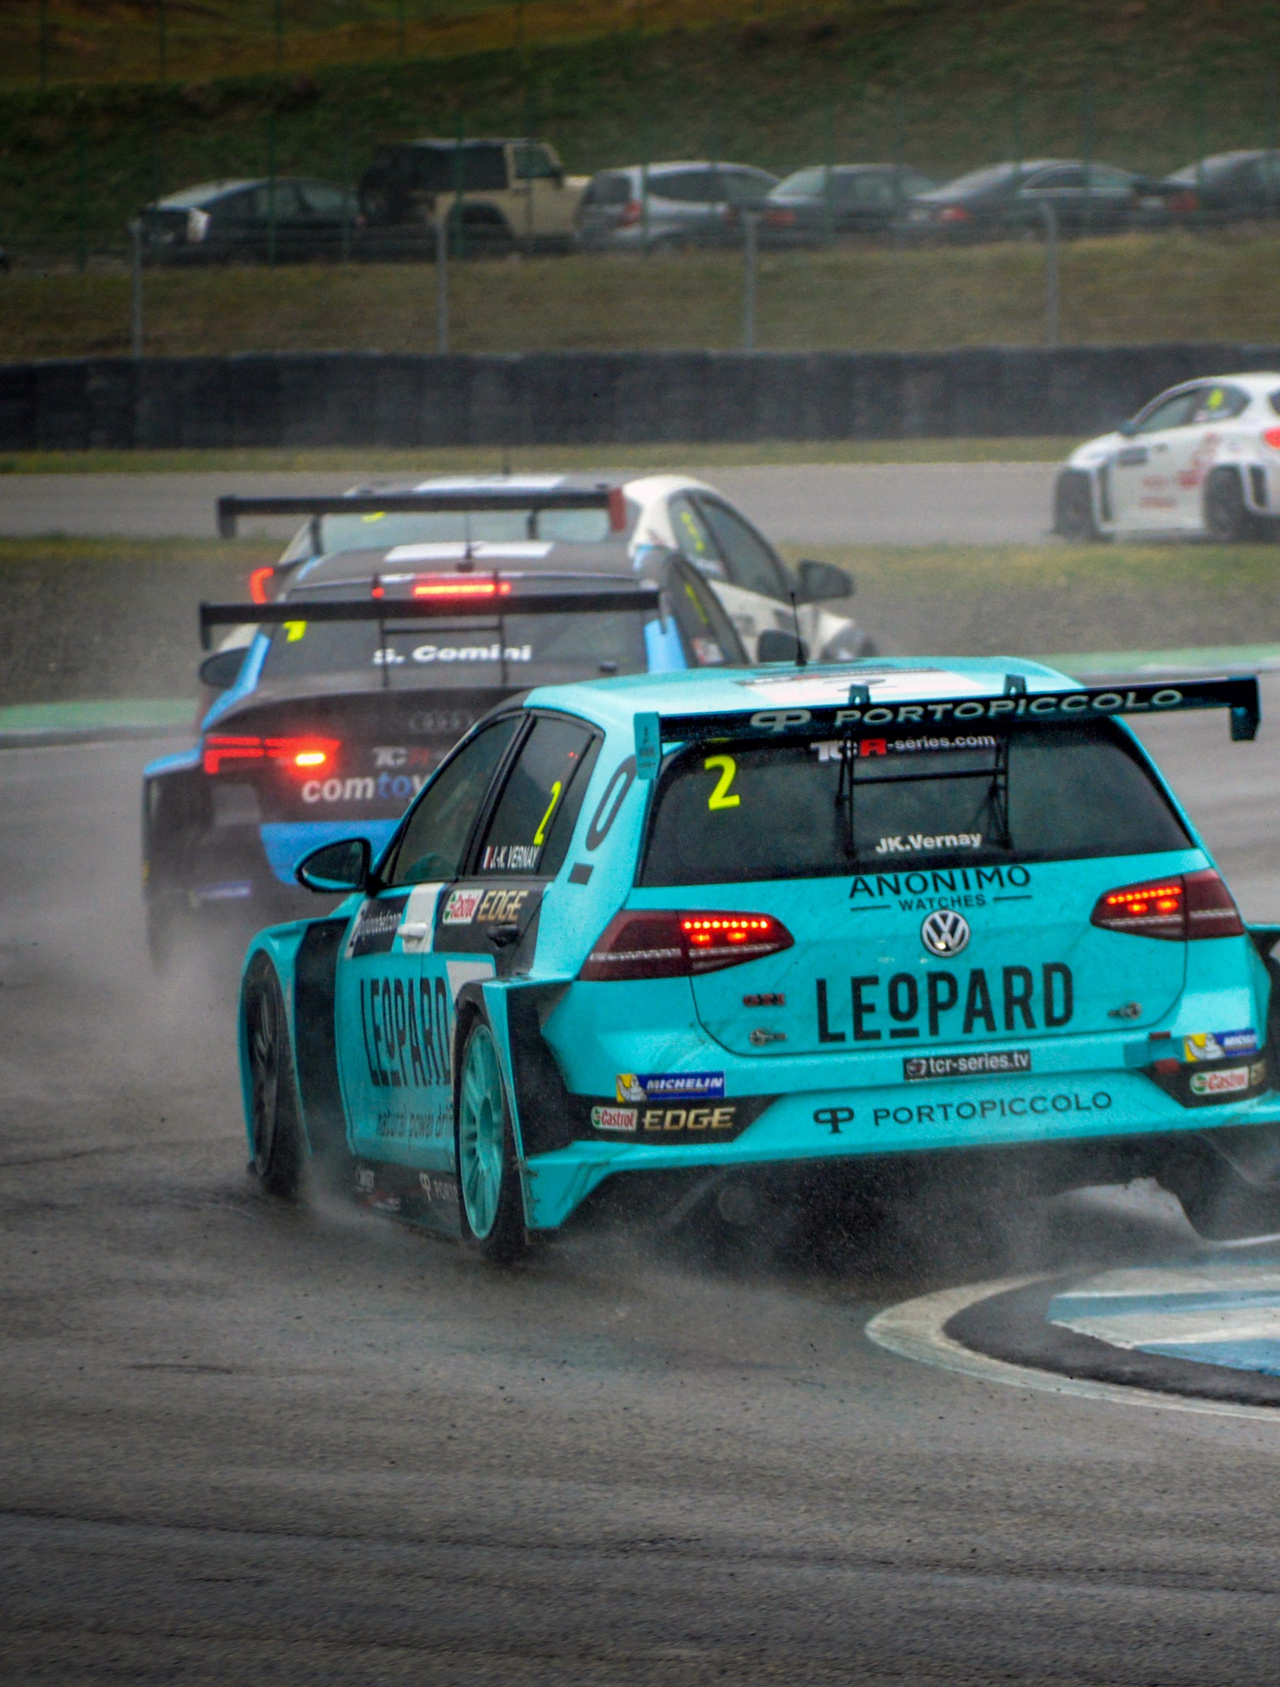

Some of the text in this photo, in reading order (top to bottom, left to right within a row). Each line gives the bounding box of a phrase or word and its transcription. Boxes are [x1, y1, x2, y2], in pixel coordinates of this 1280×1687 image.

[412, 644, 532, 662] Comini
[834, 690, 1183, 728] PORTOPICCOLO
[302, 771, 430, 802] comtoy
[704, 755, 740, 811] 2
[533, 781, 561, 846] 2
[507, 845, 541, 869] VERNAY
[876, 832, 982, 854] JK.Vernay
[849, 865, 1031, 899] ANONIMO
[477, 890, 528, 922] EDGE
[899, 894, 987, 912] WATCHES
[816, 962, 1074, 1043] LEOPARD
[360, 976, 451, 1087] LEOPARD
[929, 1051, 1030, 1075] tcr-series.tv
[646, 1076, 723, 1091] MICHELIN
[601, 1107, 736, 1131] Castrol EDGE
[873, 1091, 1112, 1126] PORTOPICCOLO
